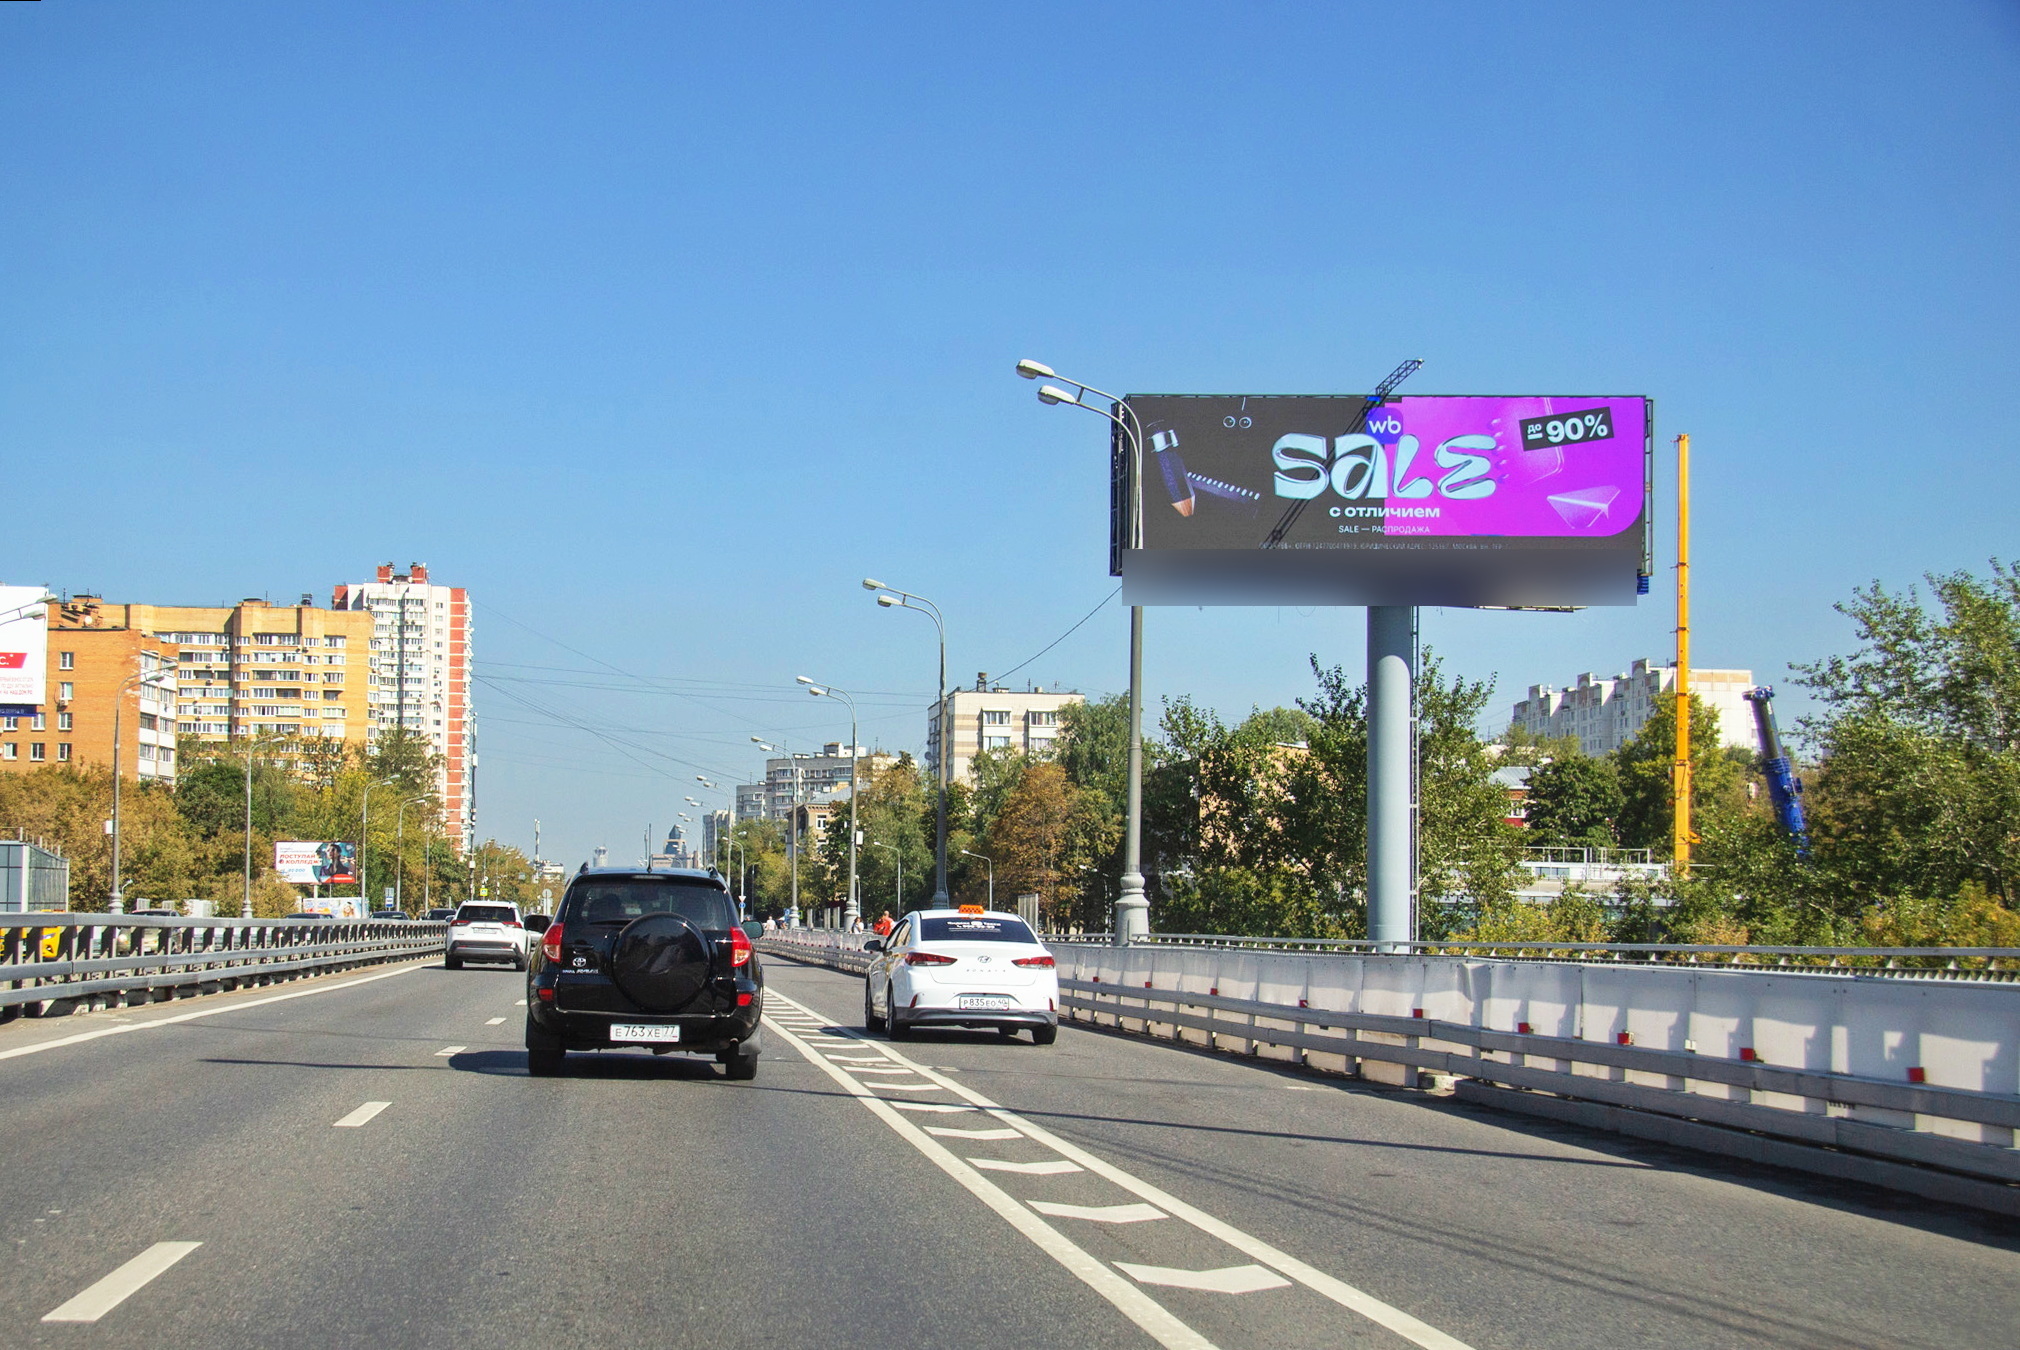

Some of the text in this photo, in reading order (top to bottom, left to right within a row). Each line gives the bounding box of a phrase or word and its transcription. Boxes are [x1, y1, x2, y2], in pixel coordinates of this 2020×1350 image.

[1368, 416, 1402, 434] wb
[1344, 507, 1440, 518] отличием
[1338, 525, 1359, 533] SALE
[1371, 525, 1431, 534] РАСПРОДАЖА
